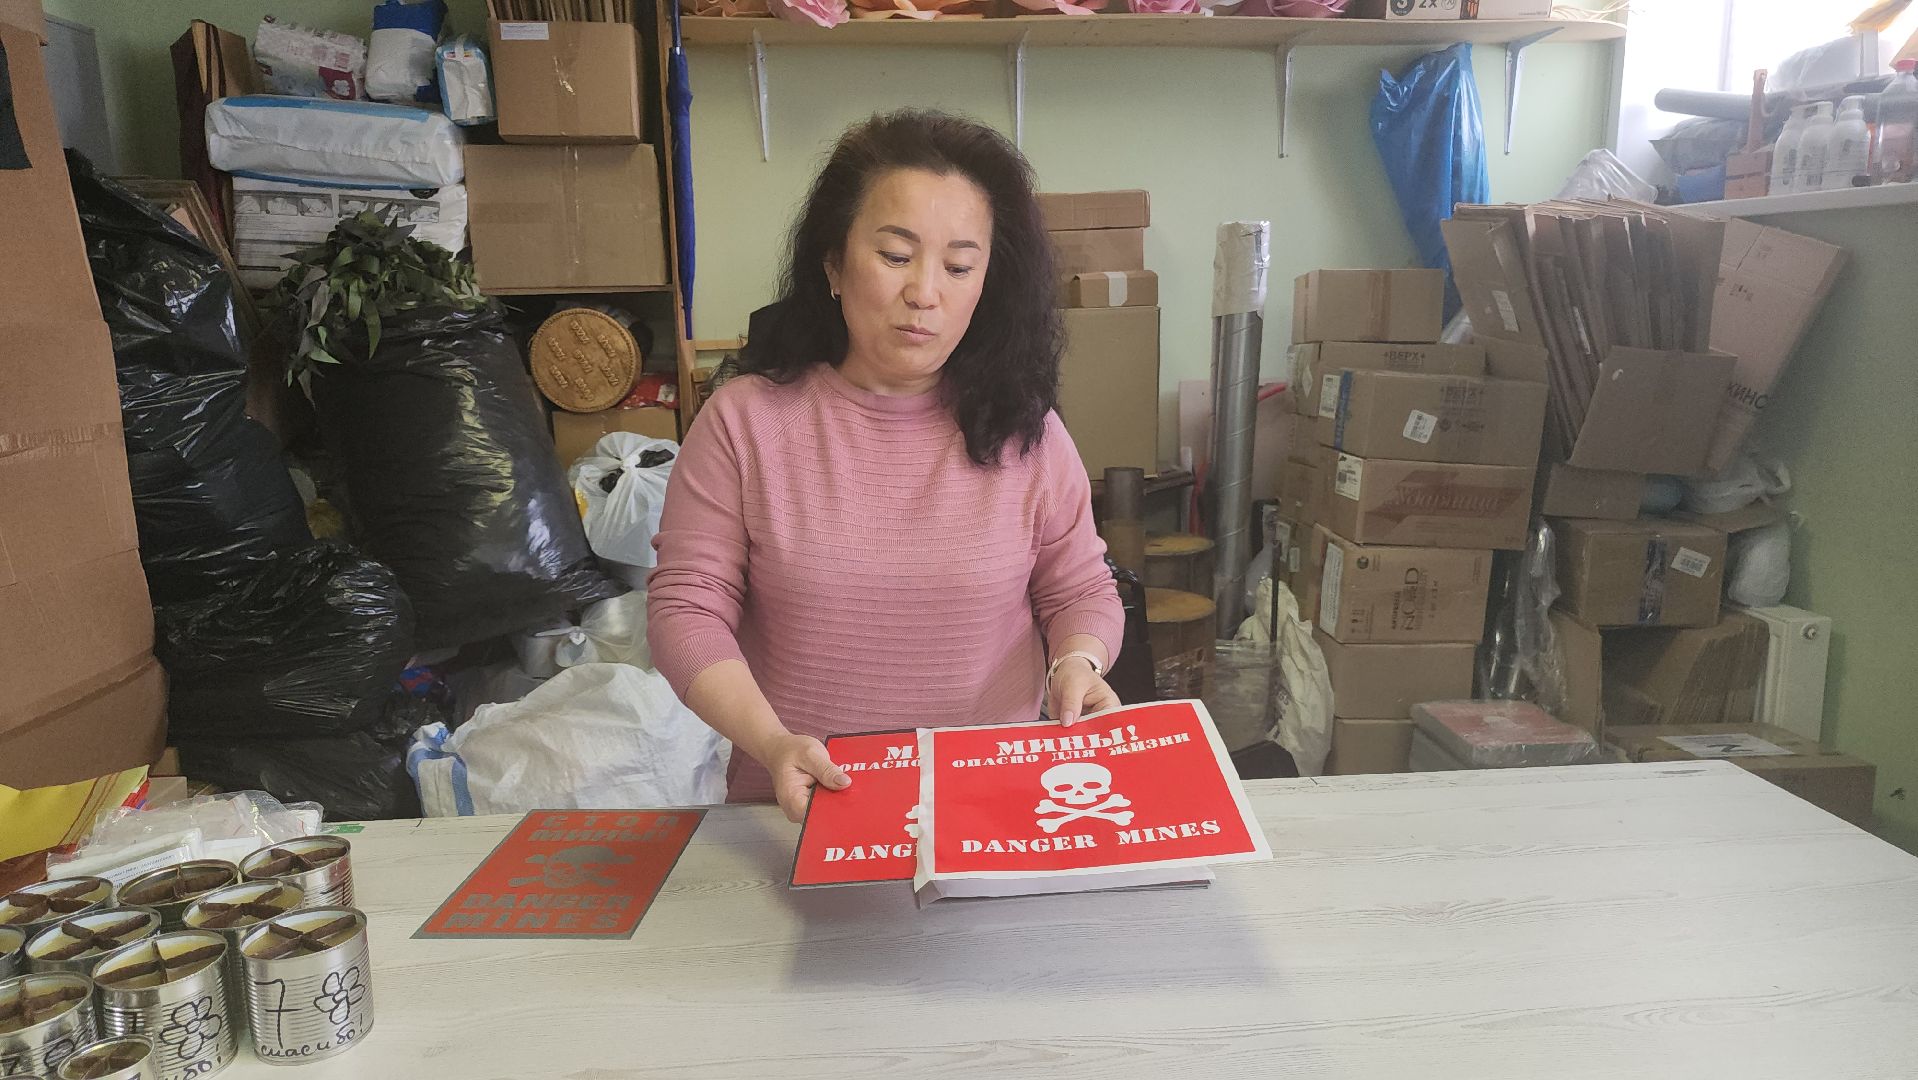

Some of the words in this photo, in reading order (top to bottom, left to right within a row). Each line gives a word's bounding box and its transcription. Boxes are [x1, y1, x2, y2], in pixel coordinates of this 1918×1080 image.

[951, 753, 1040, 768] ОПАСНО
[1052, 748, 1097, 763] ДЛЯ
[1109, 733, 1191, 756] ЖИЗНИ
[996, 725, 1139, 757] МИНЫ!
[541, 815, 680, 828] СТОП
[528, 829, 670, 842] МИНЫ!
[960, 834, 1098, 853] DANGER
[1115, 819, 1221, 846] MINES
[823, 843, 918, 862] DANG
[459, 893, 636, 910] DANGER
[444, 912, 622, 929] MINES
[254, 978, 303, 1049] 7
[260, 1012, 364, 1057] спасибо!
